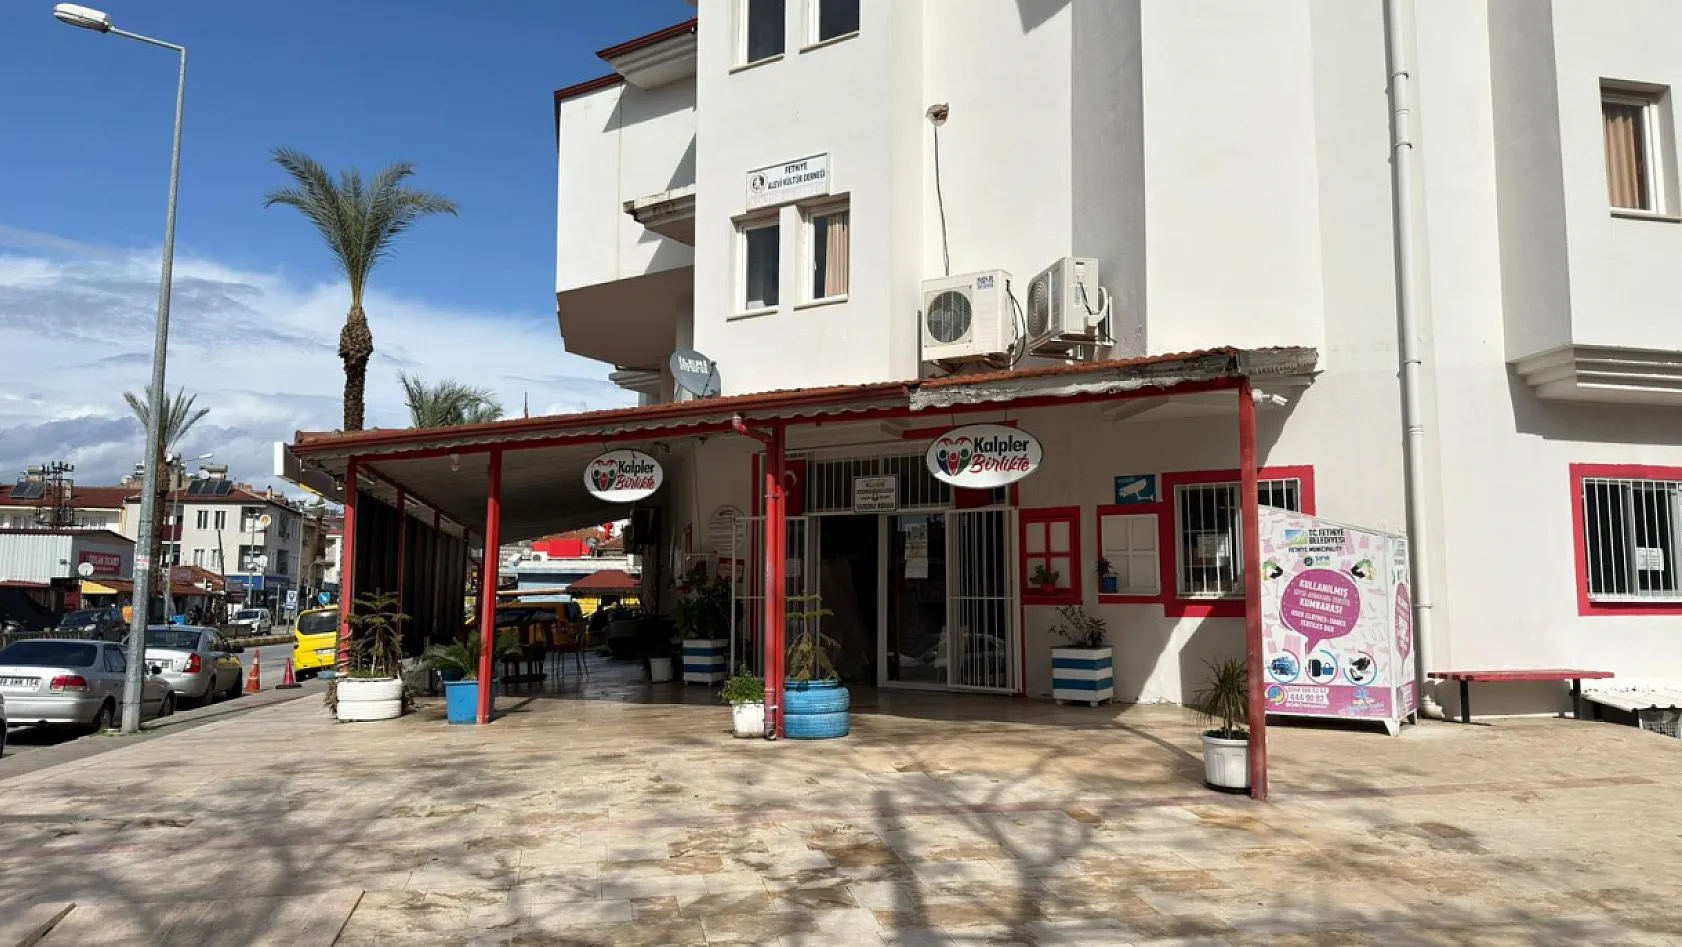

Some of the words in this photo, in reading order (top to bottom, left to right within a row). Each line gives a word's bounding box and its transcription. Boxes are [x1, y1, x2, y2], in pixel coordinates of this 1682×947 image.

[783, 174, 803, 186] KÜLTÜR
[804, 168, 826, 182] DERNEĞİ
[973, 434, 1030, 457] Kalpler
[618, 459, 655, 477] Kalpler
[969, 453, 1031, 475] Birlikte
[615, 474, 655, 491] Birlikte
[1300, 579, 1348, 598] KULLANILMIŞ
